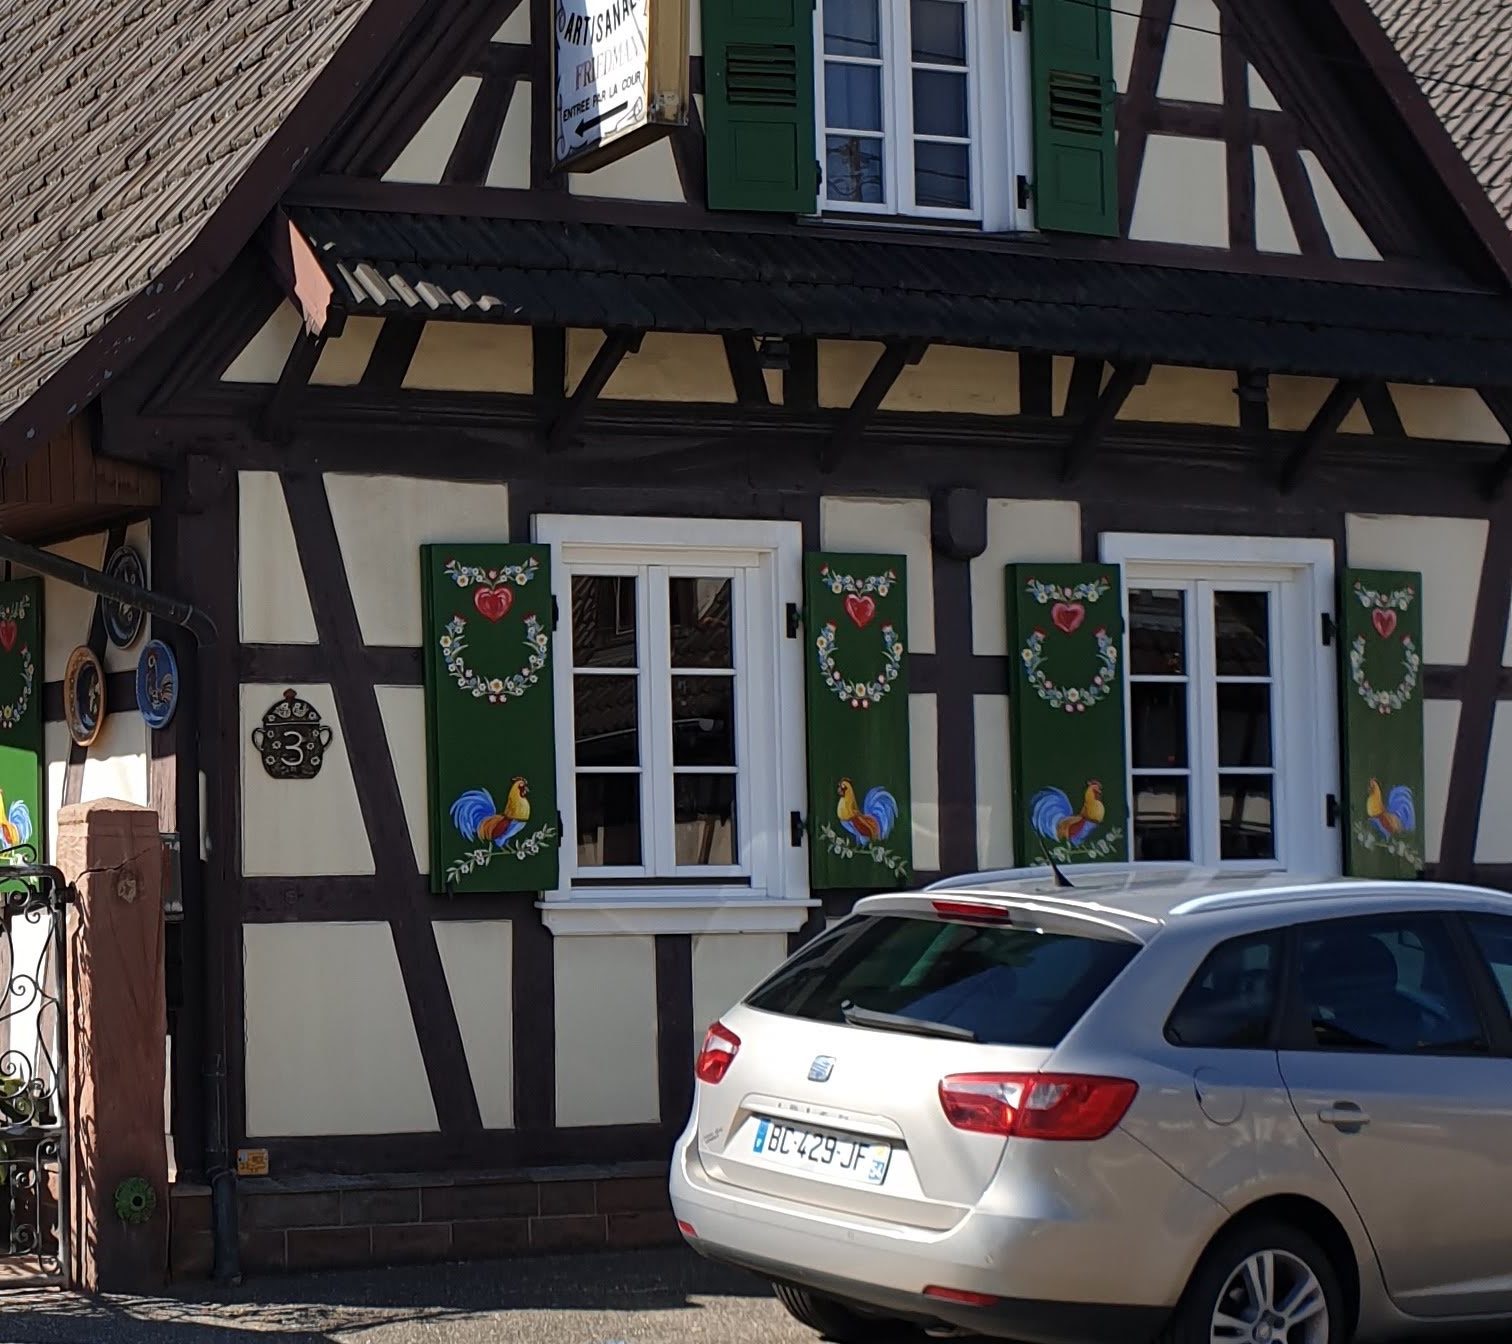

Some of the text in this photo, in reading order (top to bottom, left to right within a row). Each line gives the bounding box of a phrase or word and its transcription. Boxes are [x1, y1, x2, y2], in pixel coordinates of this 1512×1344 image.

[609, 84, 618, 98] LA
[621, 71, 641, 91] COUR
[281, 731, 304, 766] 3
